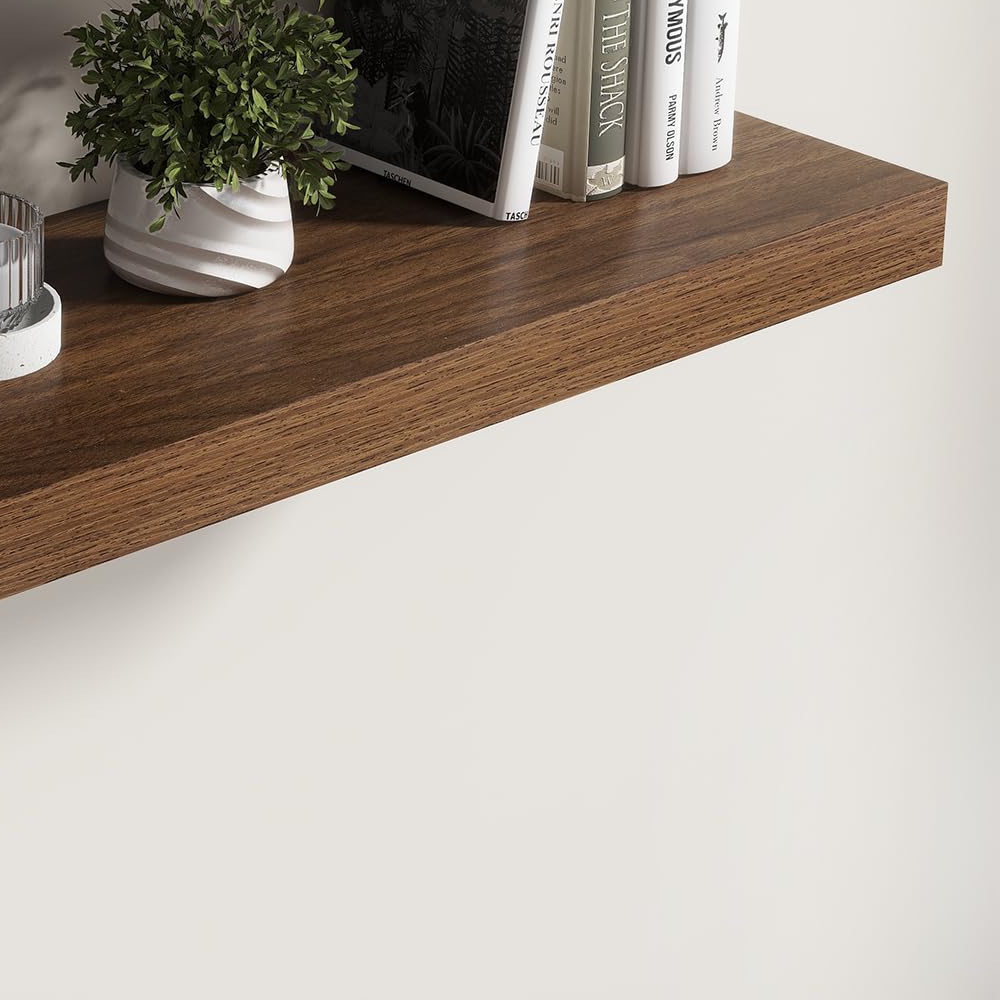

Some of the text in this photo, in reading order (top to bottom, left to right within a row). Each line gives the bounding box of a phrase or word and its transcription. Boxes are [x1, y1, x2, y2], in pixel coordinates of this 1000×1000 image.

[530, 42, 556, 147] ROUSSEAU
[598, 2, 631, 137] THE SHACK
[711, 76, 724, 151] Andrew Brown
[665, 94, 678, 161] PARMY OLSON
